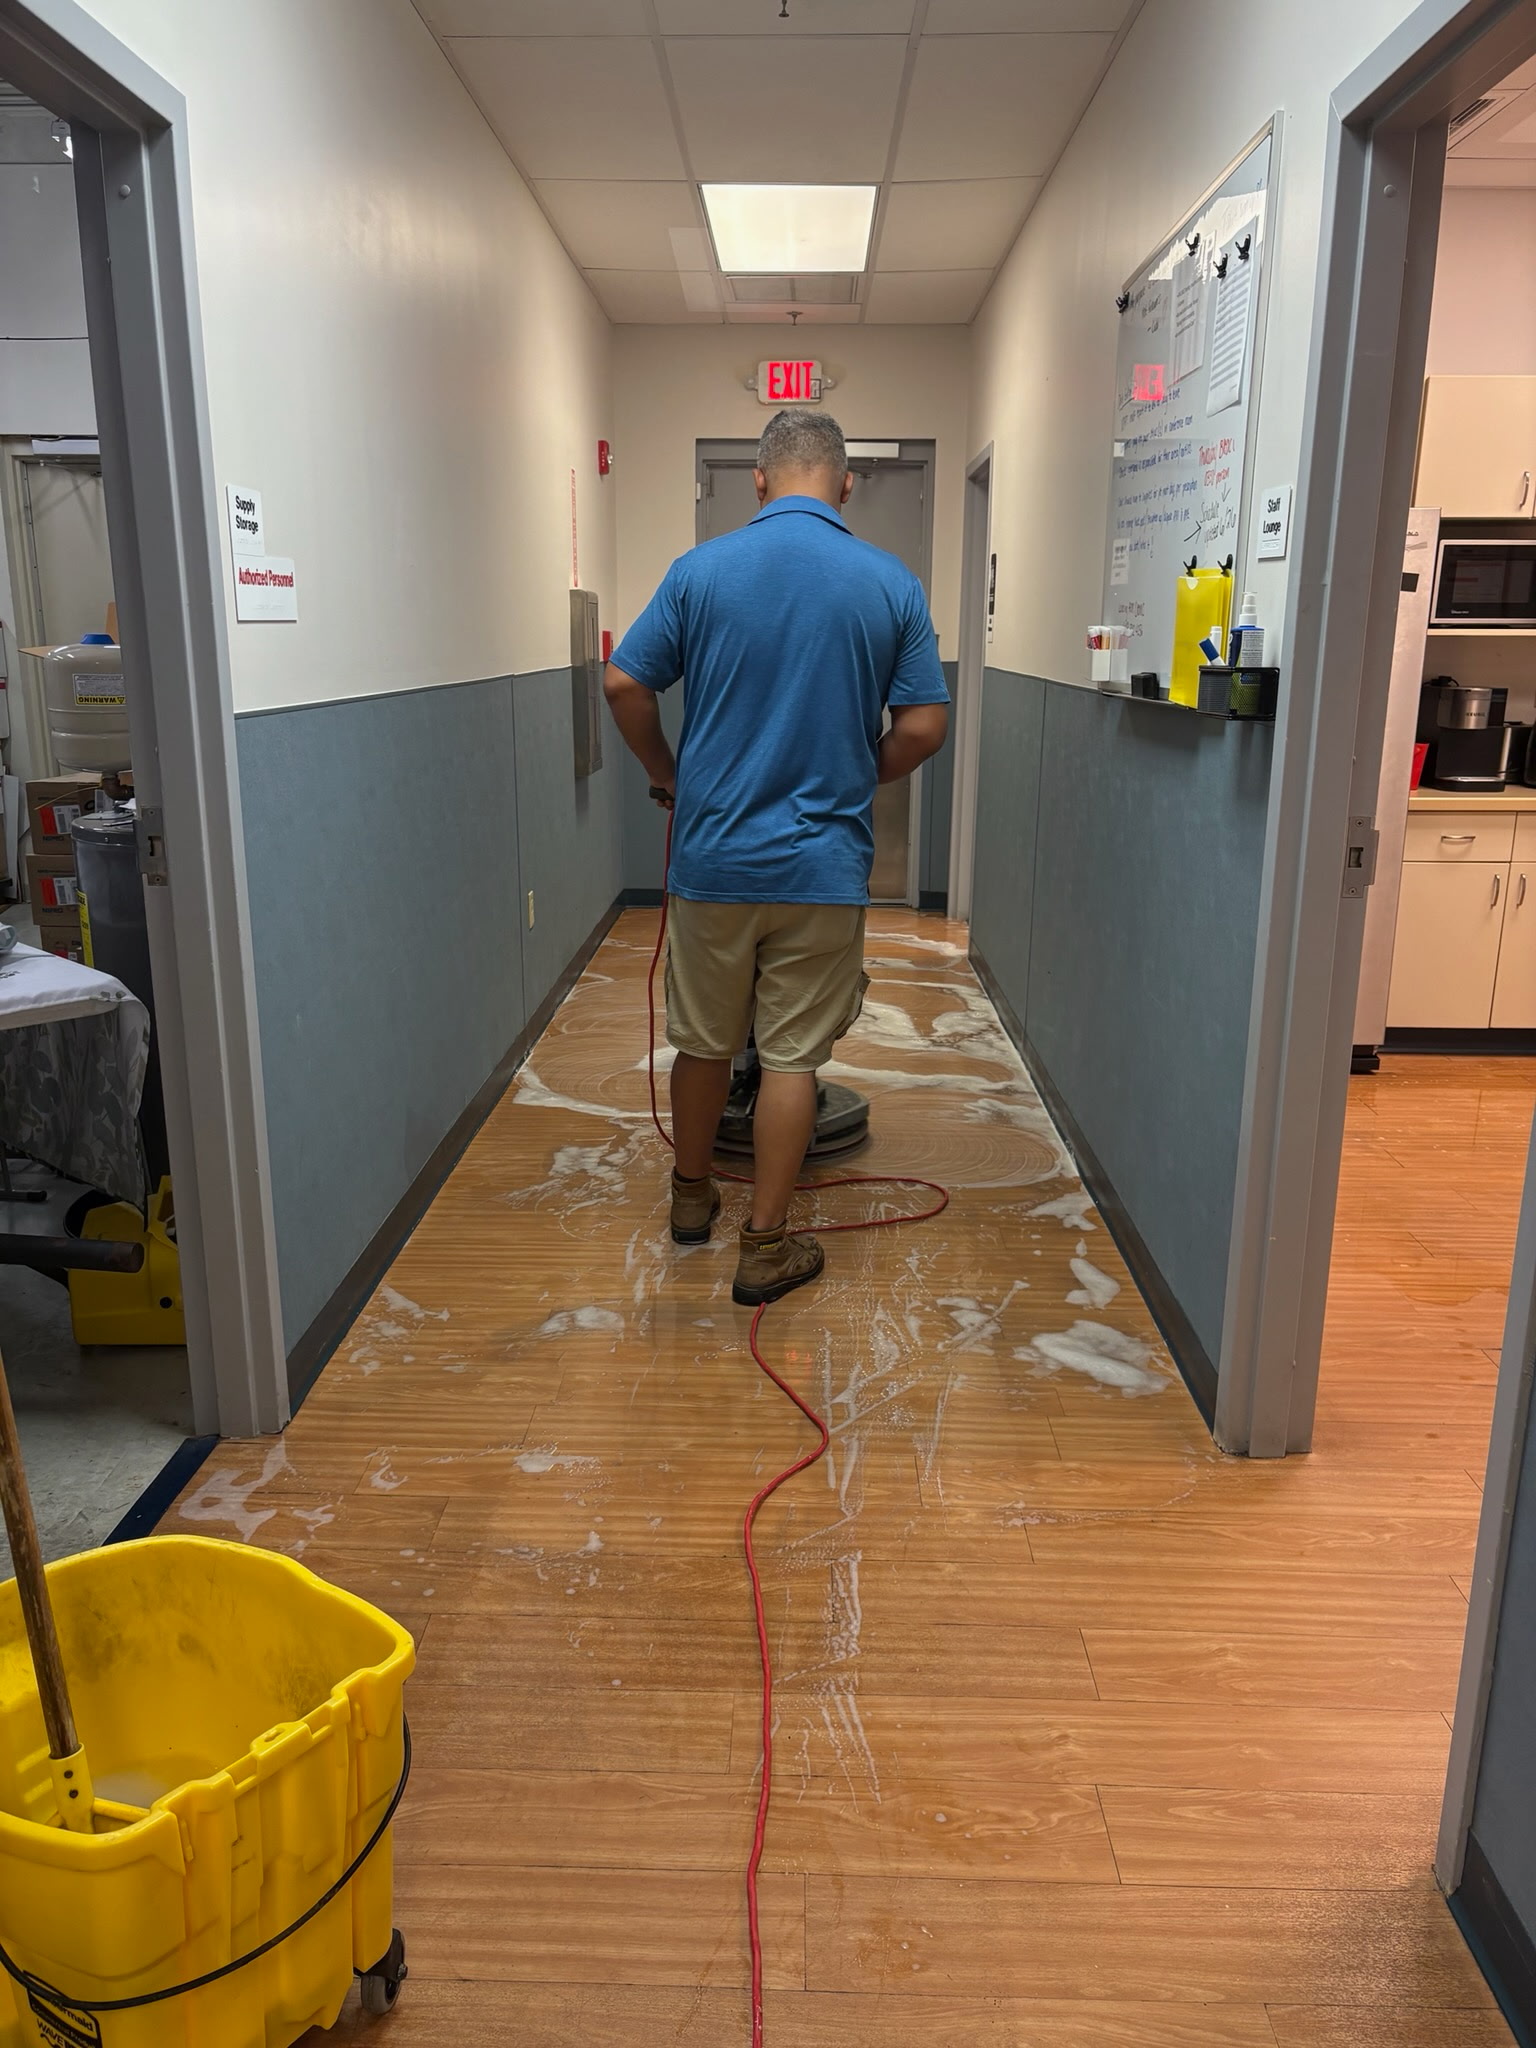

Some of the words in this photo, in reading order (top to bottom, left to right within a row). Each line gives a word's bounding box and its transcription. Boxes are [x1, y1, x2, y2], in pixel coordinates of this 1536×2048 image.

[768, 362, 814, 400] EXIT
[235, 495, 255, 516] Supply
[1267, 497, 1281, 513] Staff
[235, 515, 259, 535] Storage
[1263, 520, 1281, 536] Lounge
[238, 567, 268, 586] Authorized
[268, 569, 294, 588] Personnel
